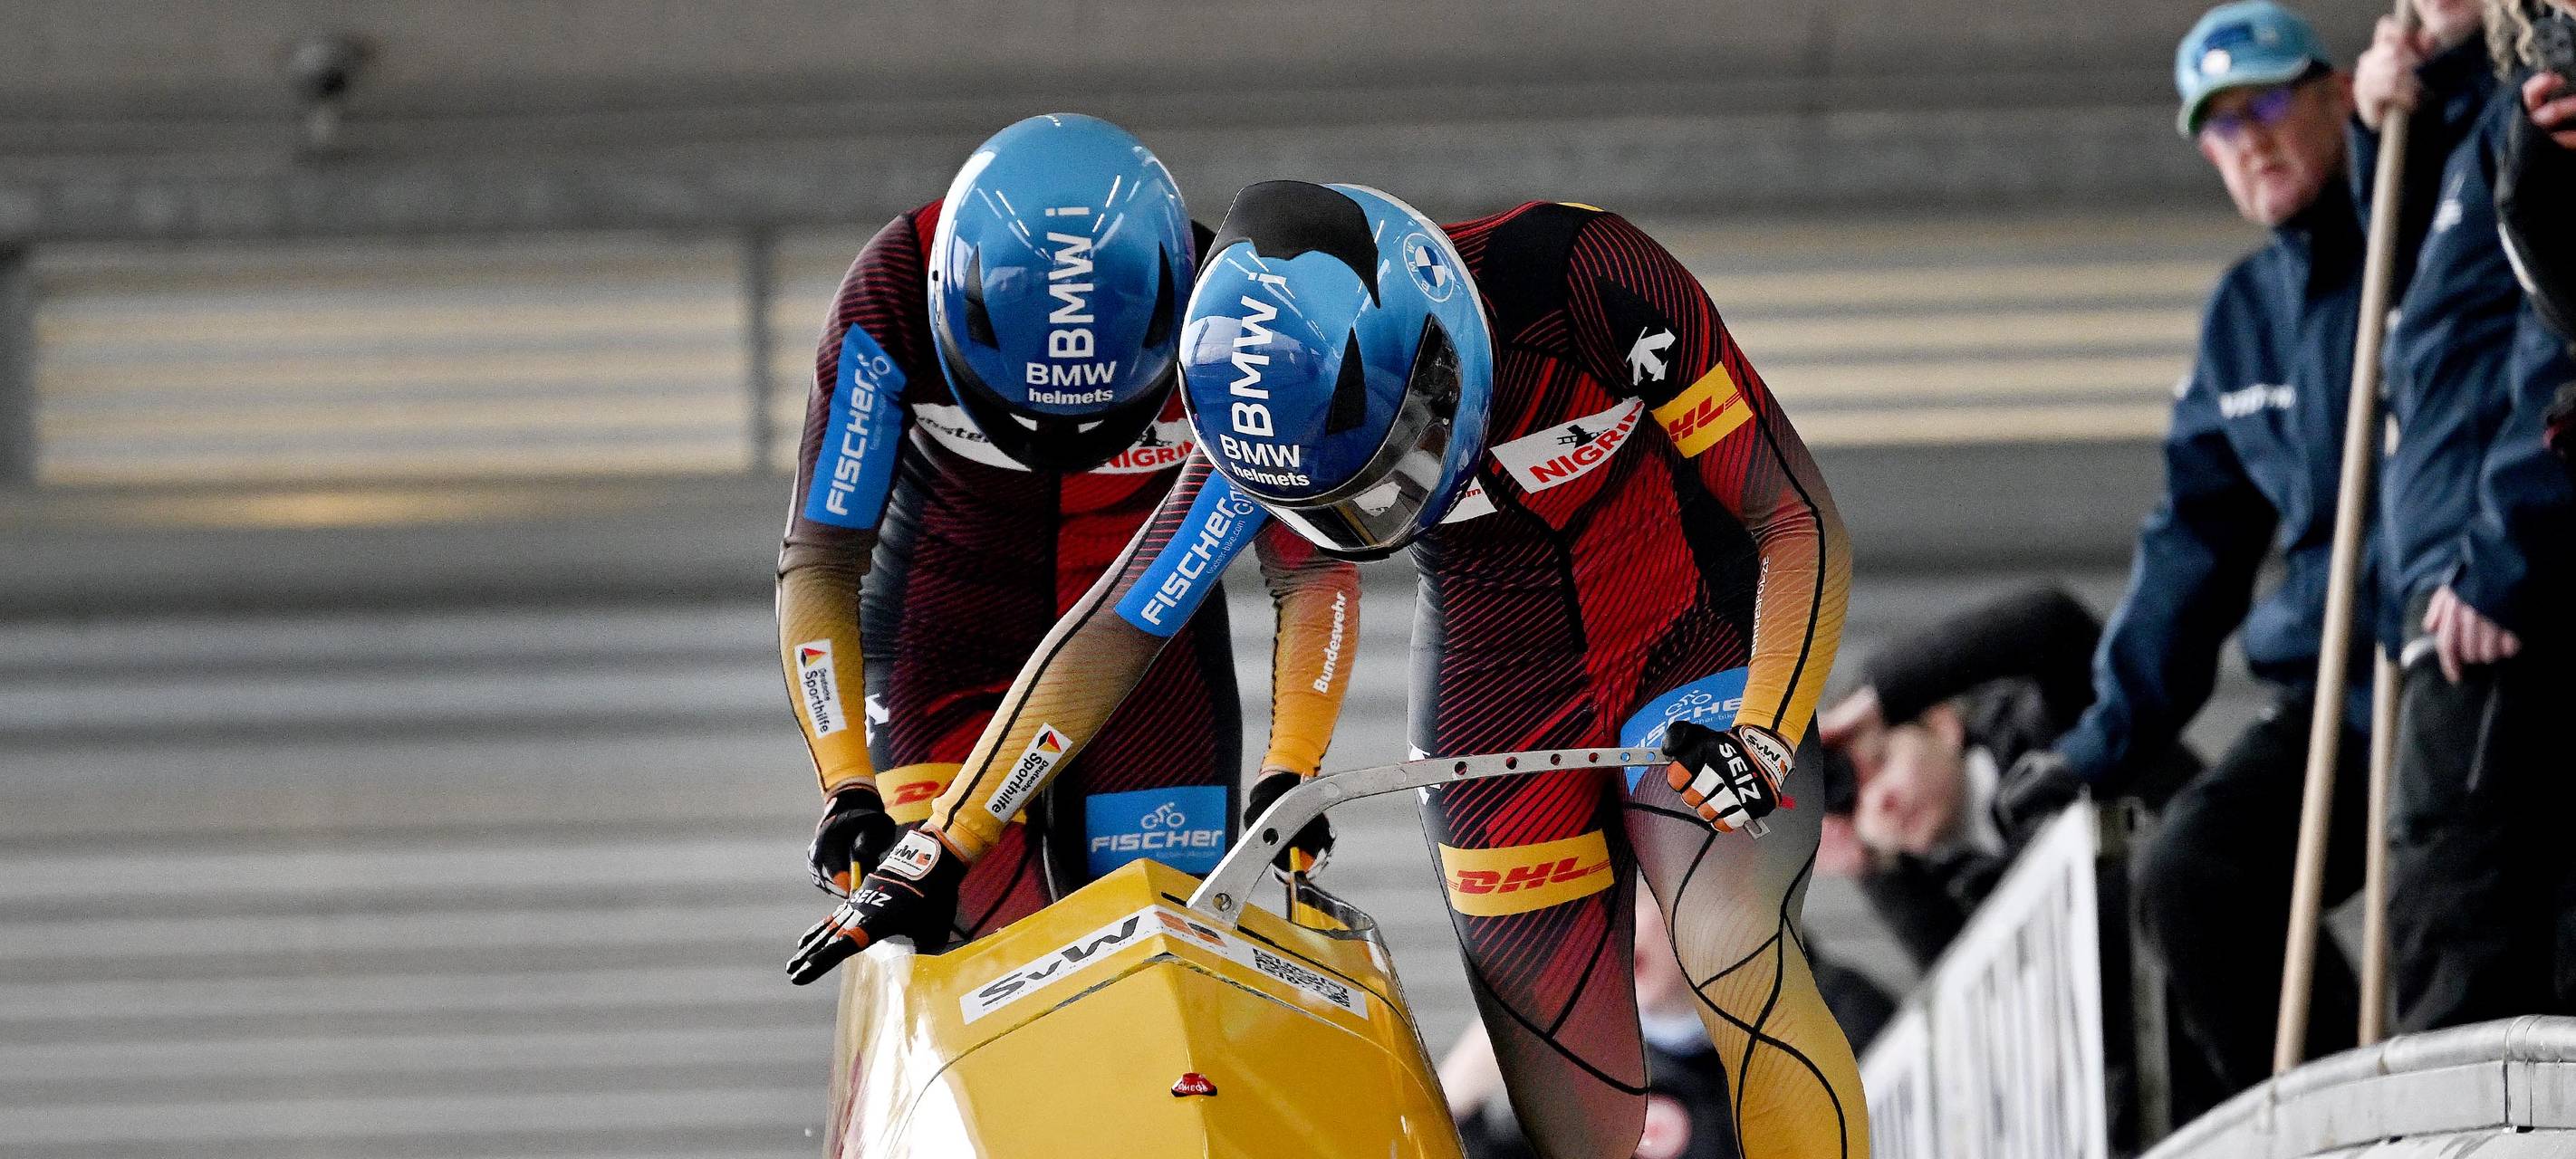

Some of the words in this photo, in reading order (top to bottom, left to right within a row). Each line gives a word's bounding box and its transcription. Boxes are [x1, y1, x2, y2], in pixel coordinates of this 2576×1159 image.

[1046, 232, 1095, 359] BMW
[1026, 361, 1117, 386] BMW
[1230, 295, 1279, 437] BMW
[1029, 388, 1113, 405] helmets
[1668, 395, 1725, 443] HL
[1220, 433, 1300, 468] BMW
[1230, 461, 1311, 486] helmets
[1312, 591, 1348, 694] Bundeswehr
[803, 670, 830, 733] Sporthilfe
[991, 752, 1043, 813] Sporthilfe
[1021, 760, 1049, 792] Deutsche
[1719, 742, 1762, 804] SEIZ
[850, 889, 893, 907] SEIZ
[1456, 856, 1591, 894] DHL
[978, 915, 1139, 1007] SvW
